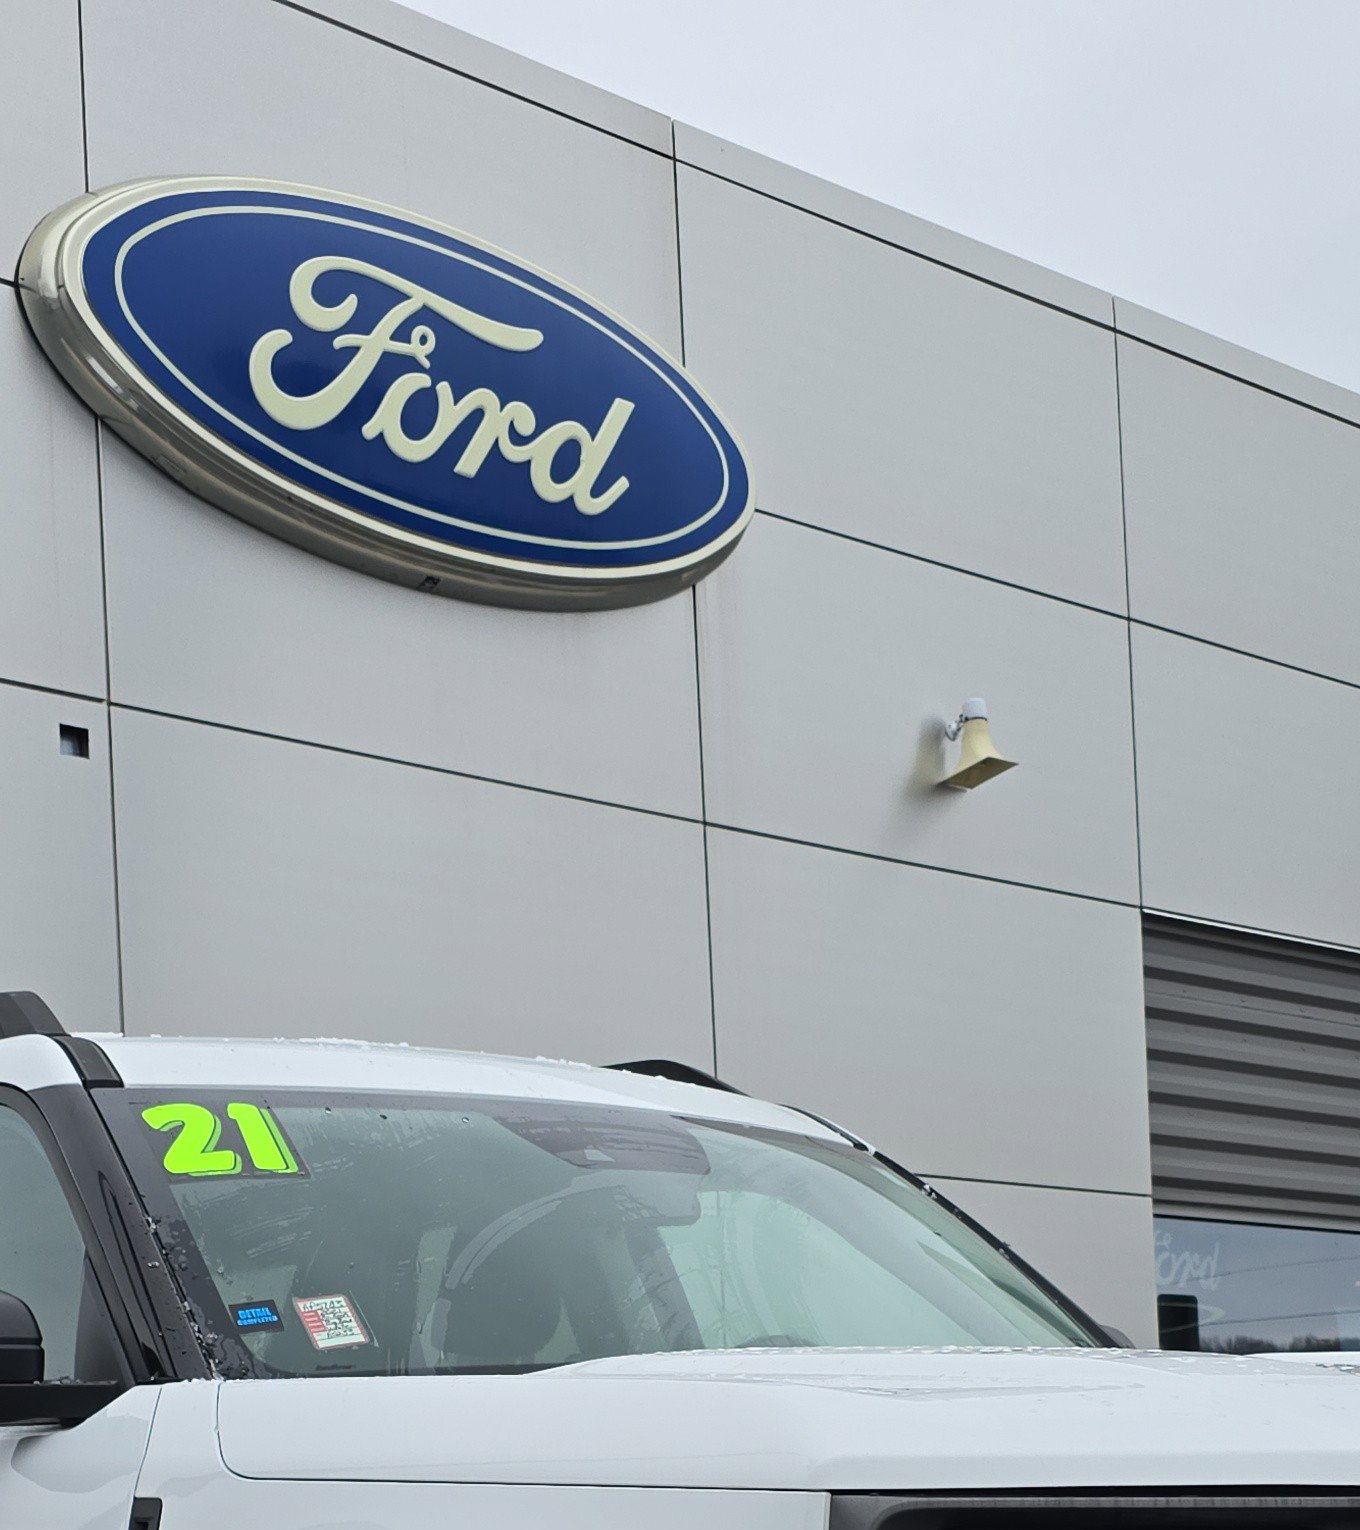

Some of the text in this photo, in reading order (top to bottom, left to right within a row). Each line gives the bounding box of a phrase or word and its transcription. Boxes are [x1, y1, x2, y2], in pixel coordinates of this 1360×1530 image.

[249, 255, 636, 516] Ford
[141, 1103, 299, 1177] 21
[1154, 1230, 1220, 1292] ord
